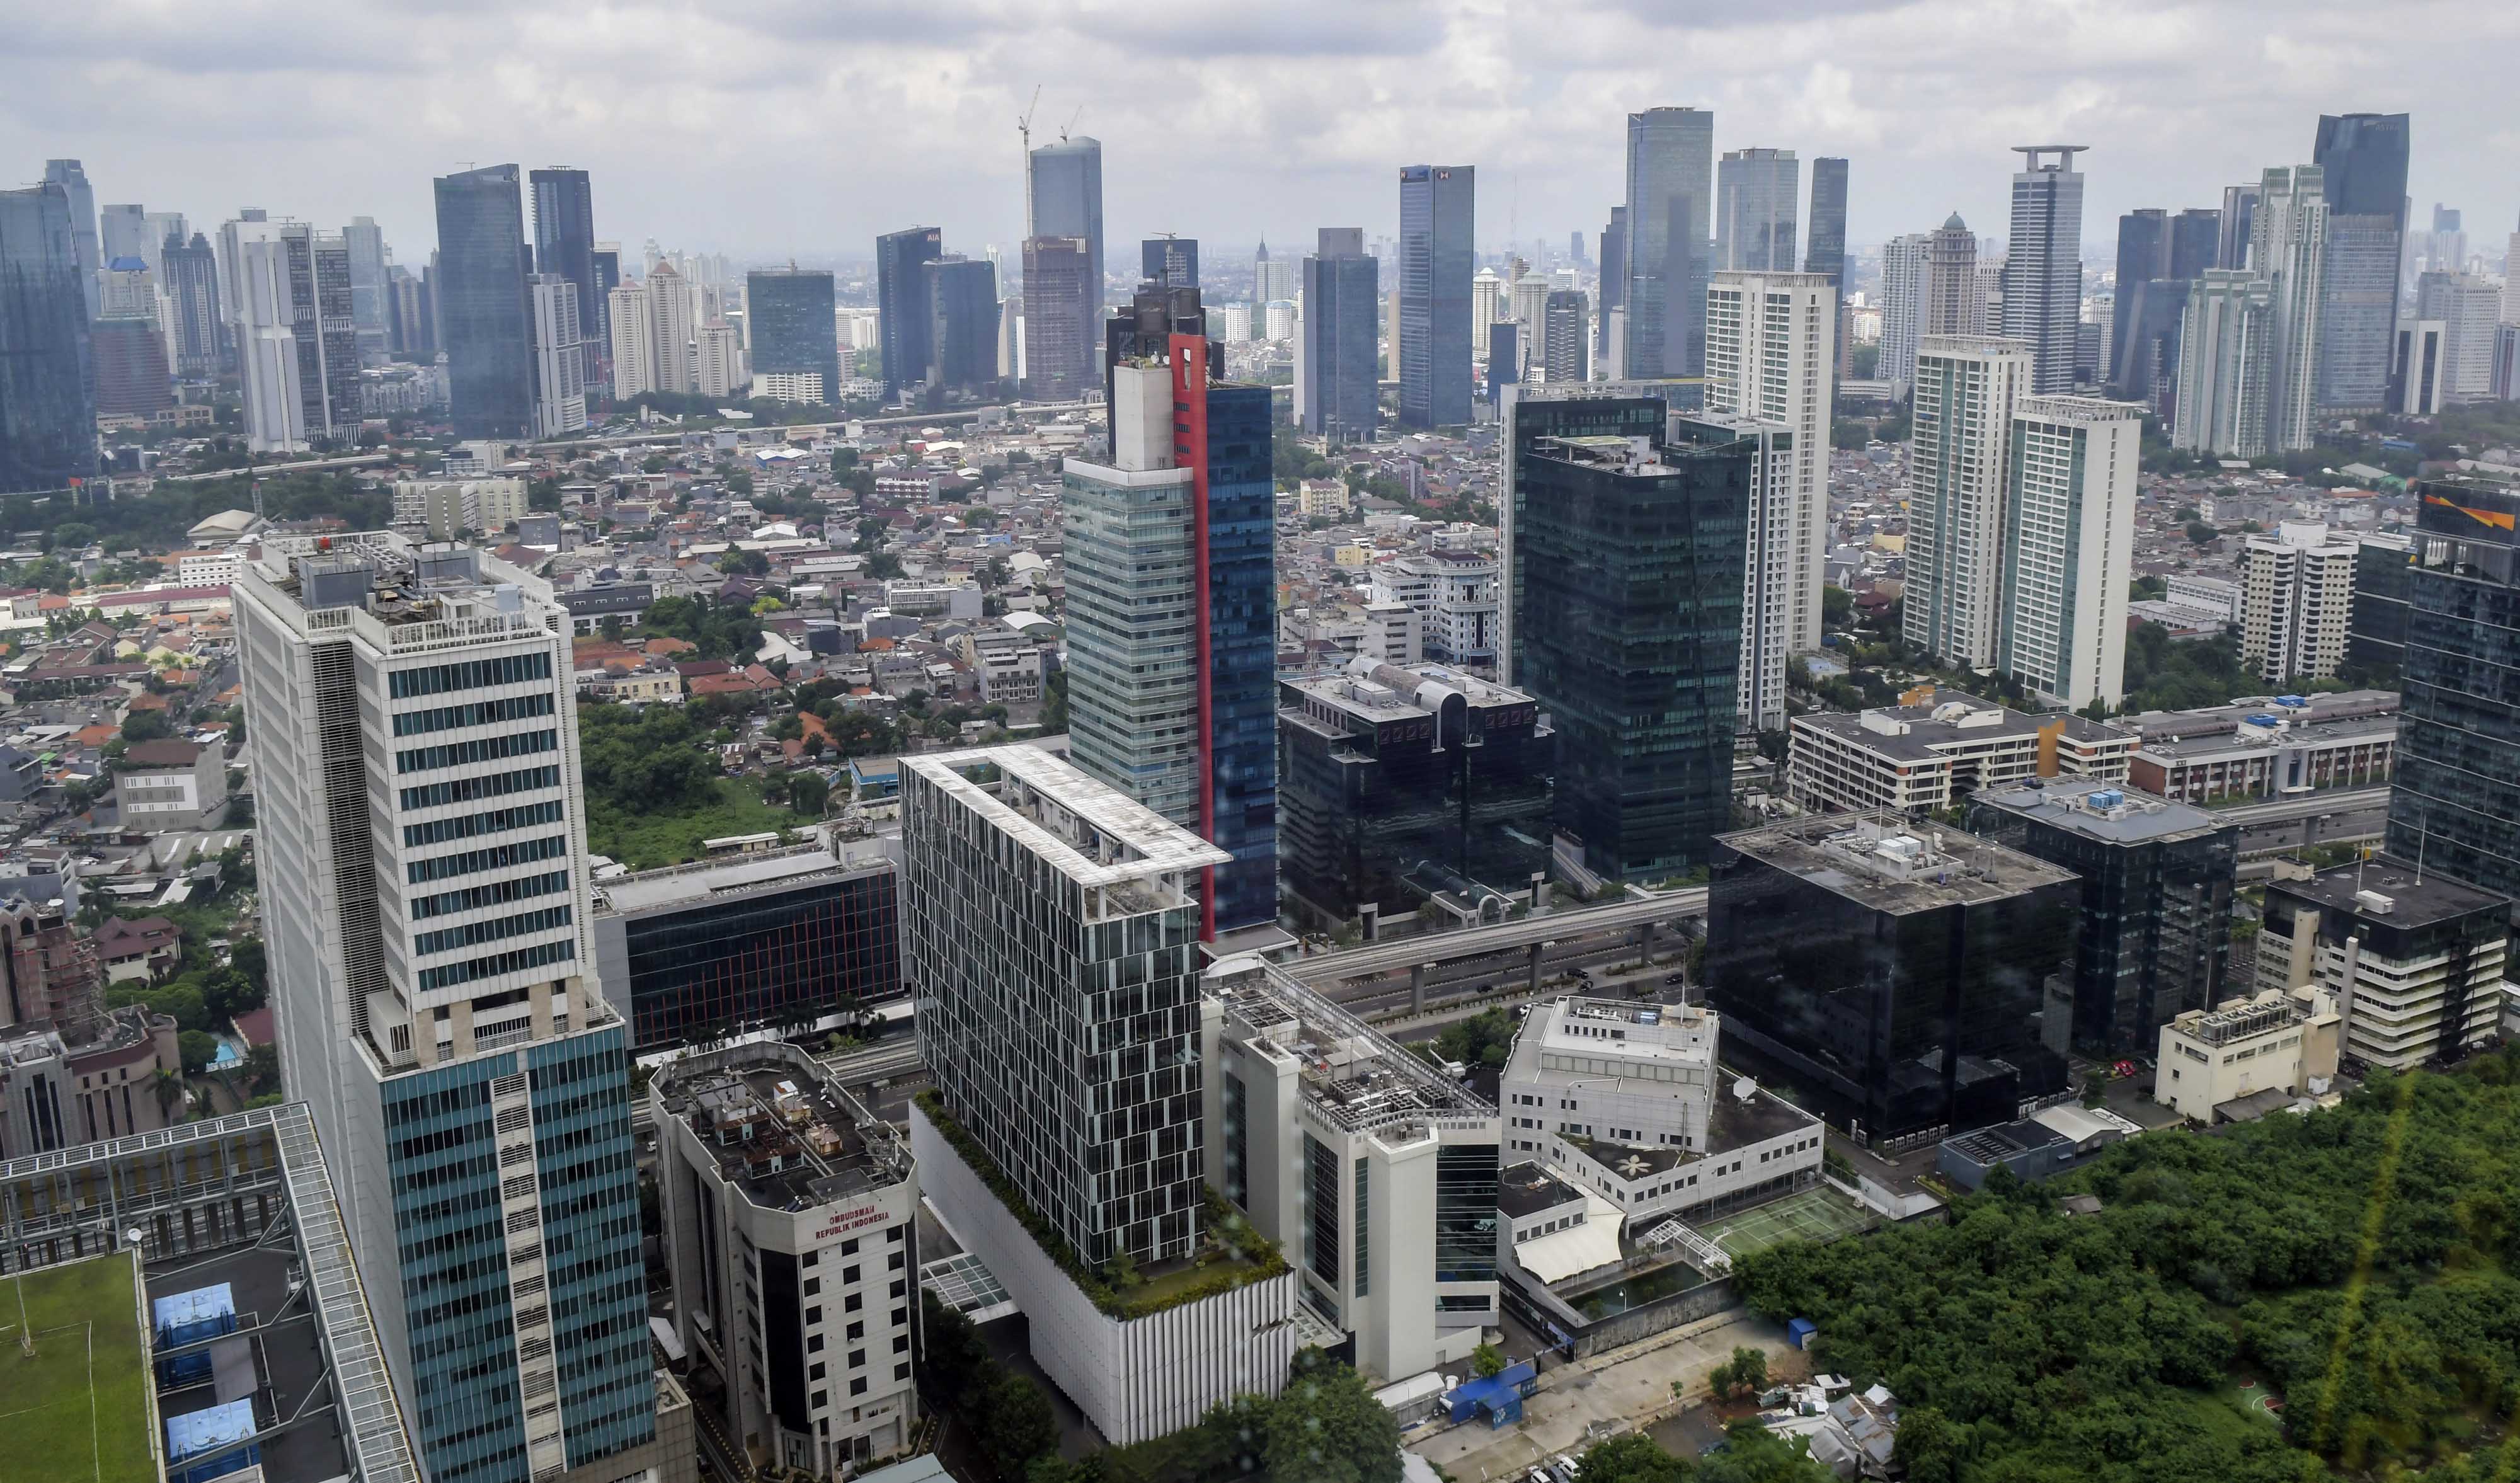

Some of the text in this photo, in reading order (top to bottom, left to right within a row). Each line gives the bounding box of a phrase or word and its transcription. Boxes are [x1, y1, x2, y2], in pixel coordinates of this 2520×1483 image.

[927, 234, 940, 242] AIA
[829, 1205, 874, 1225] OMBUDSMAN
[816, 1211, 890, 1240] REPUBLIK INDONESIA
